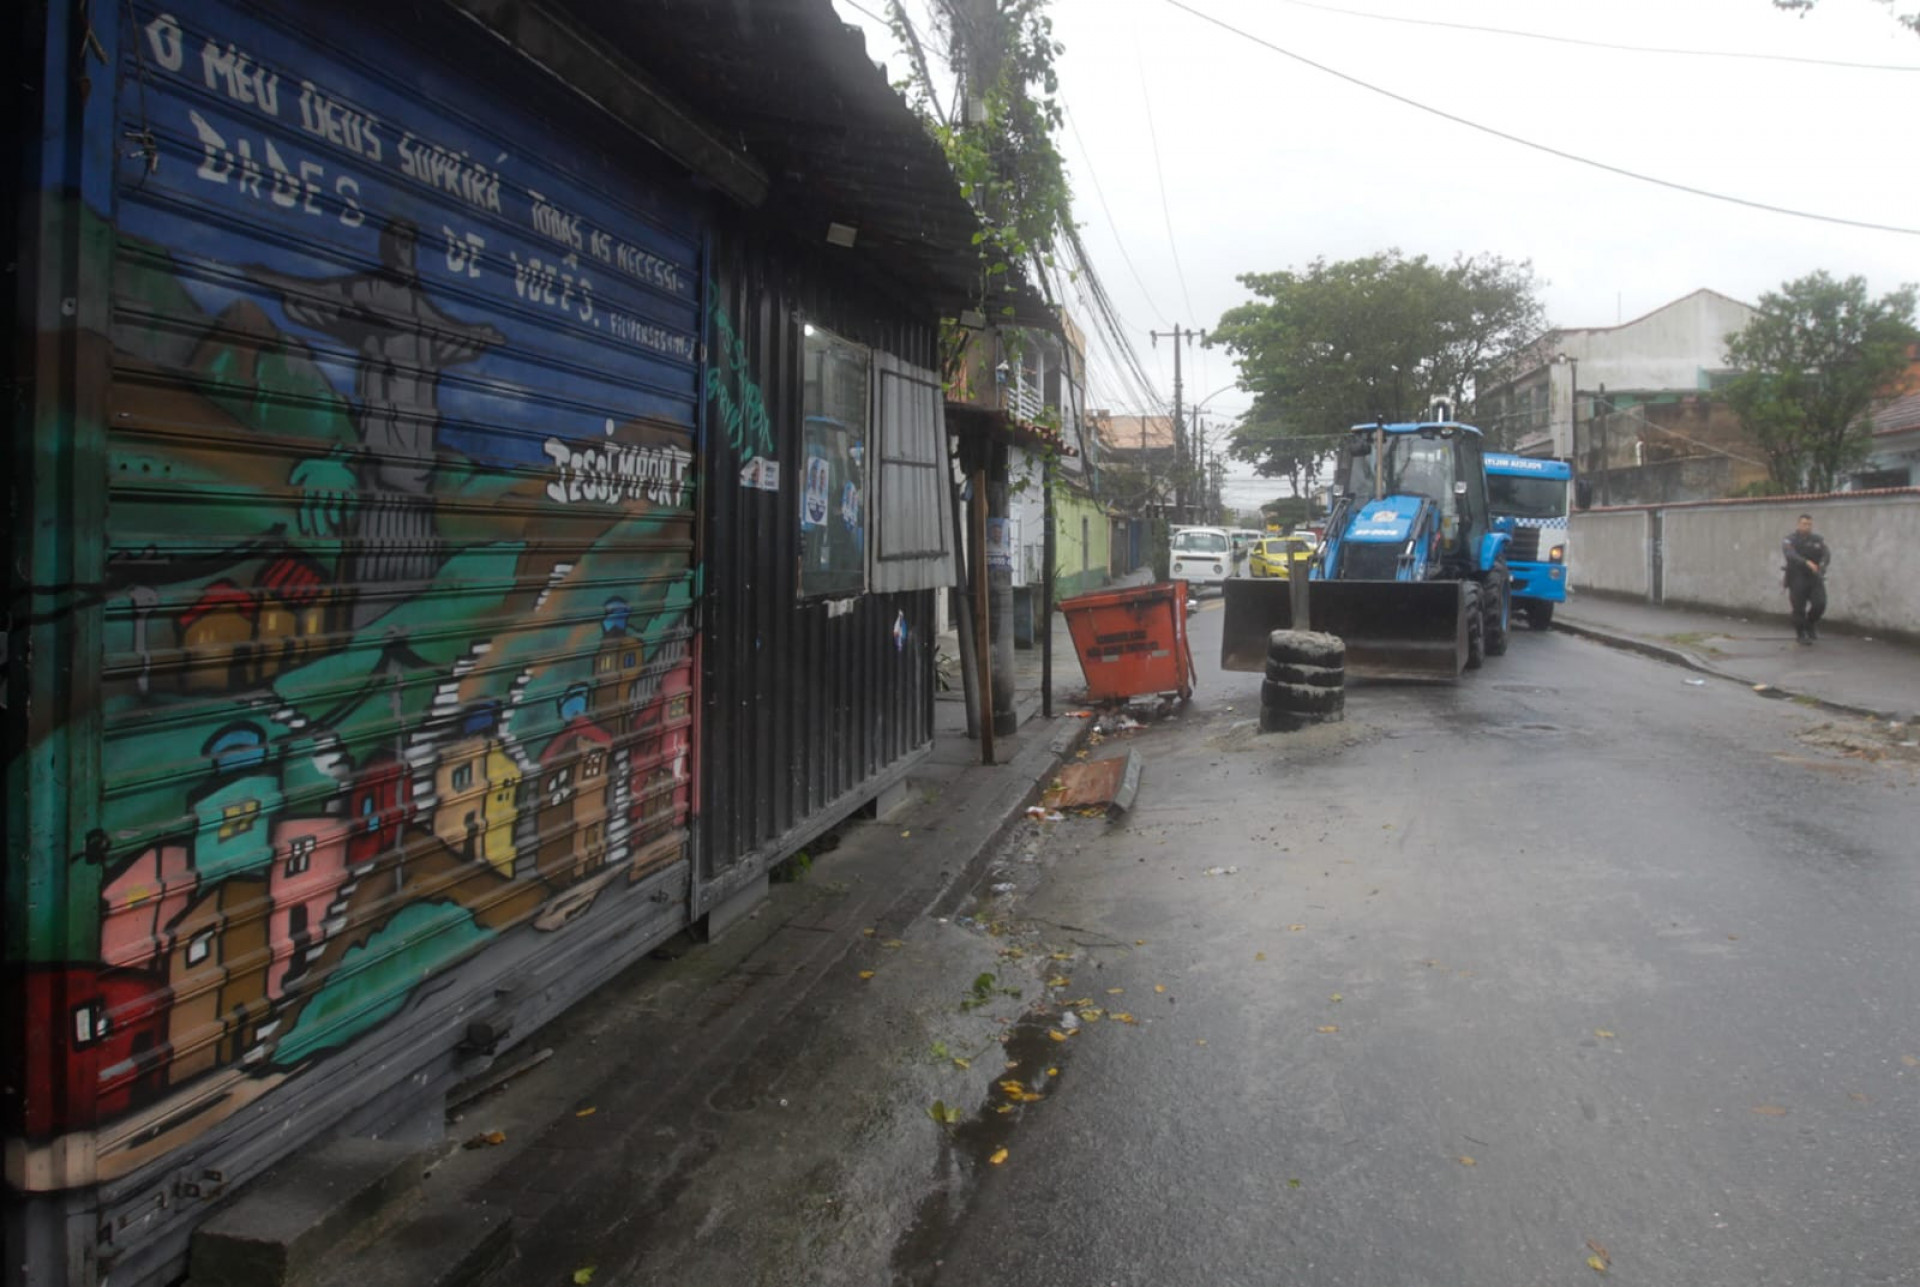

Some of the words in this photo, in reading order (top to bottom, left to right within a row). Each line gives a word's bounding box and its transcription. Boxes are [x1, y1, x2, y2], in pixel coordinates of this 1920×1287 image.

[189, 109, 365, 228] DADES
[442, 225, 486, 278] DE
[201, 39, 279, 116] MEU
[299, 80, 382, 162] DEUS
[527, 189, 583, 250] TODAS
[590, 229, 613, 264] AS
